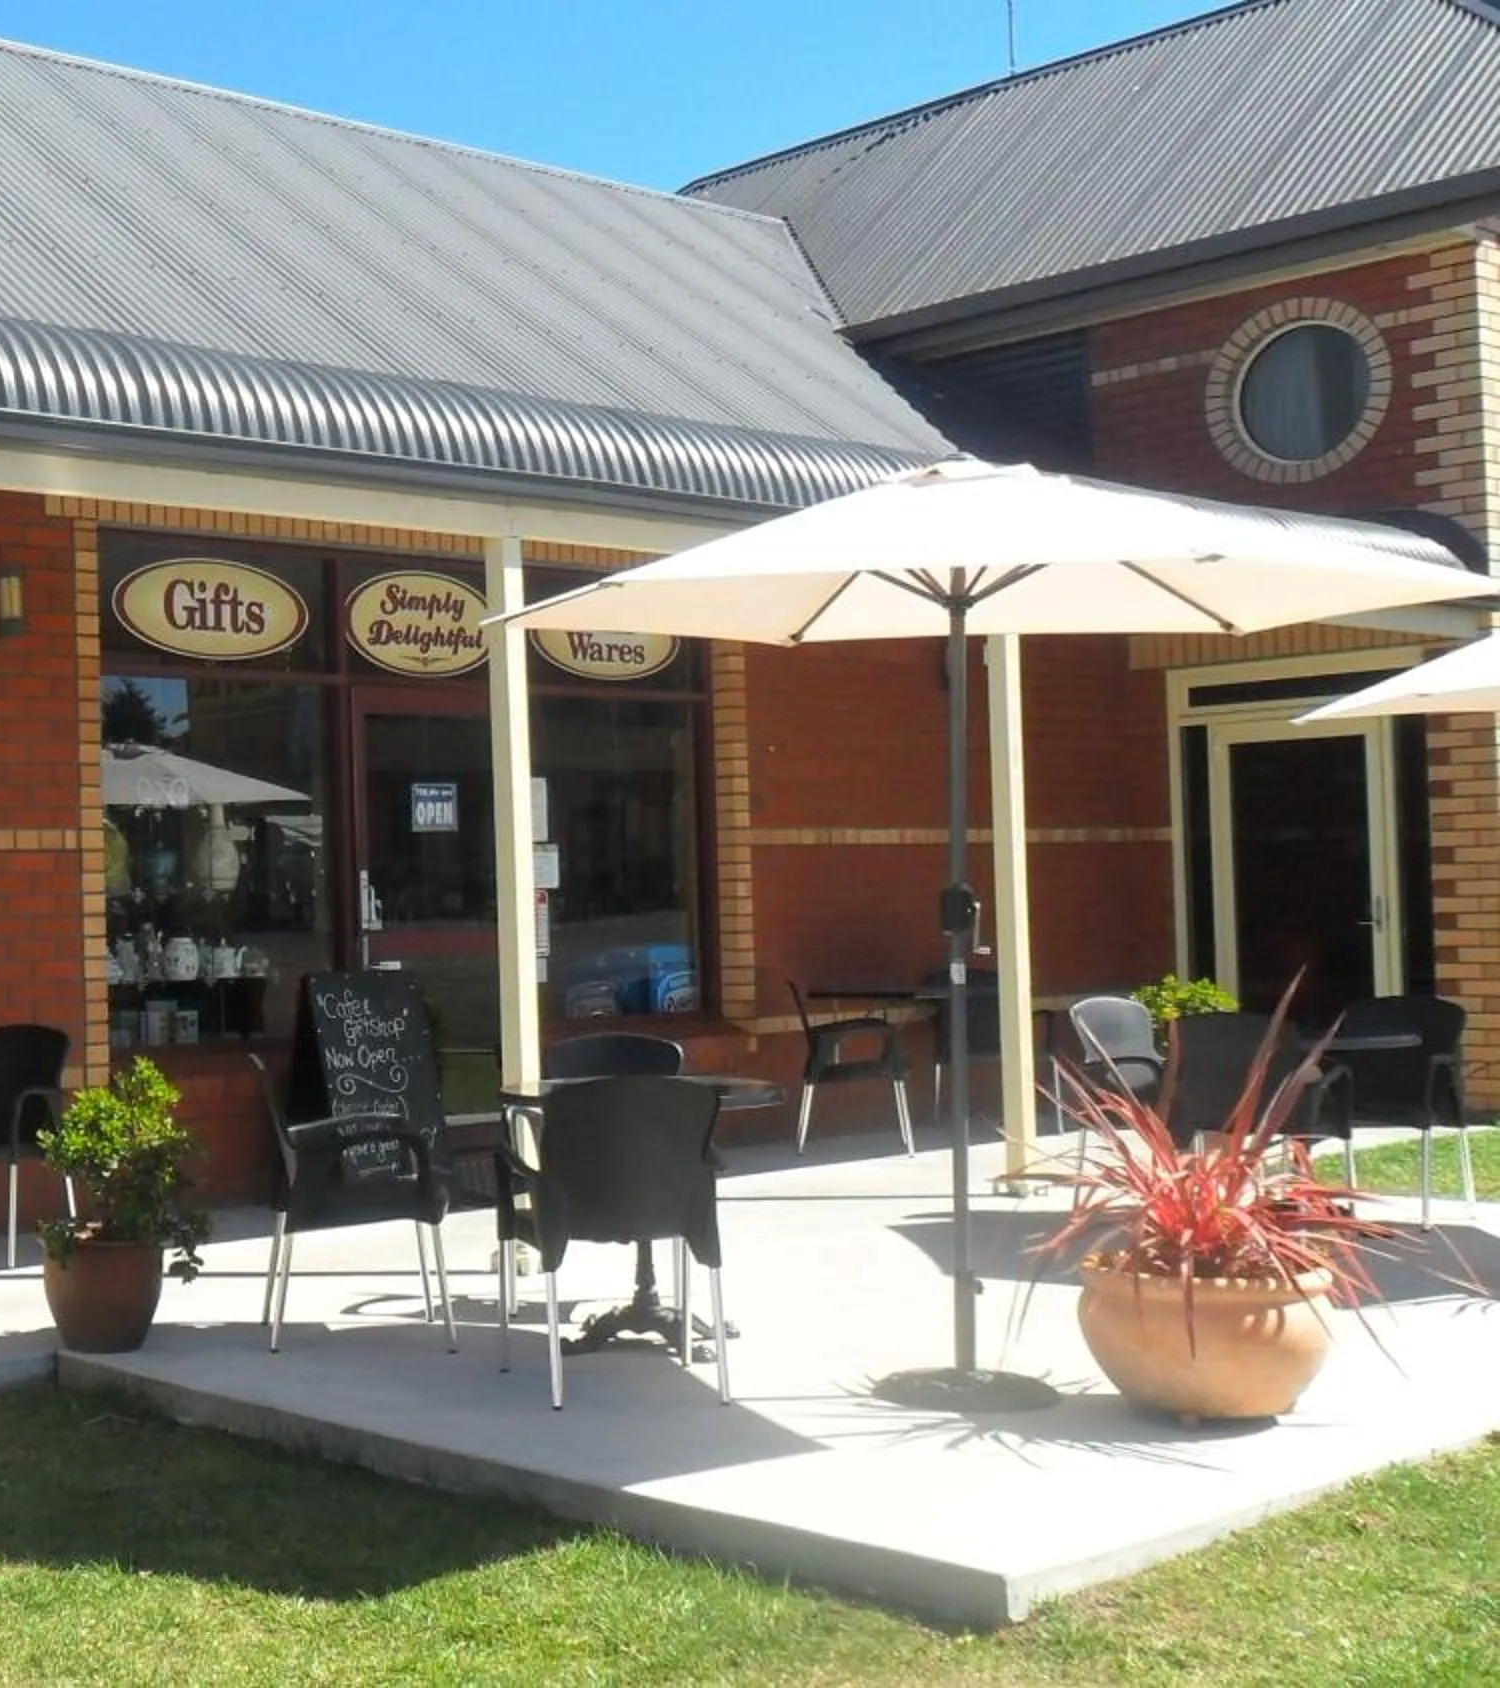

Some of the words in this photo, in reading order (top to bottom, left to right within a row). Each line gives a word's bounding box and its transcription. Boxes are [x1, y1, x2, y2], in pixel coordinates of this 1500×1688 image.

[163, 578, 266, 636] Gifts
[380, 583, 465, 622] Simply
[367, 619, 483, 655] Delightful
[566, 631, 645, 664] Wares
[416, 801, 453, 825] OPEN
[325, 1047, 355, 1069] Now
